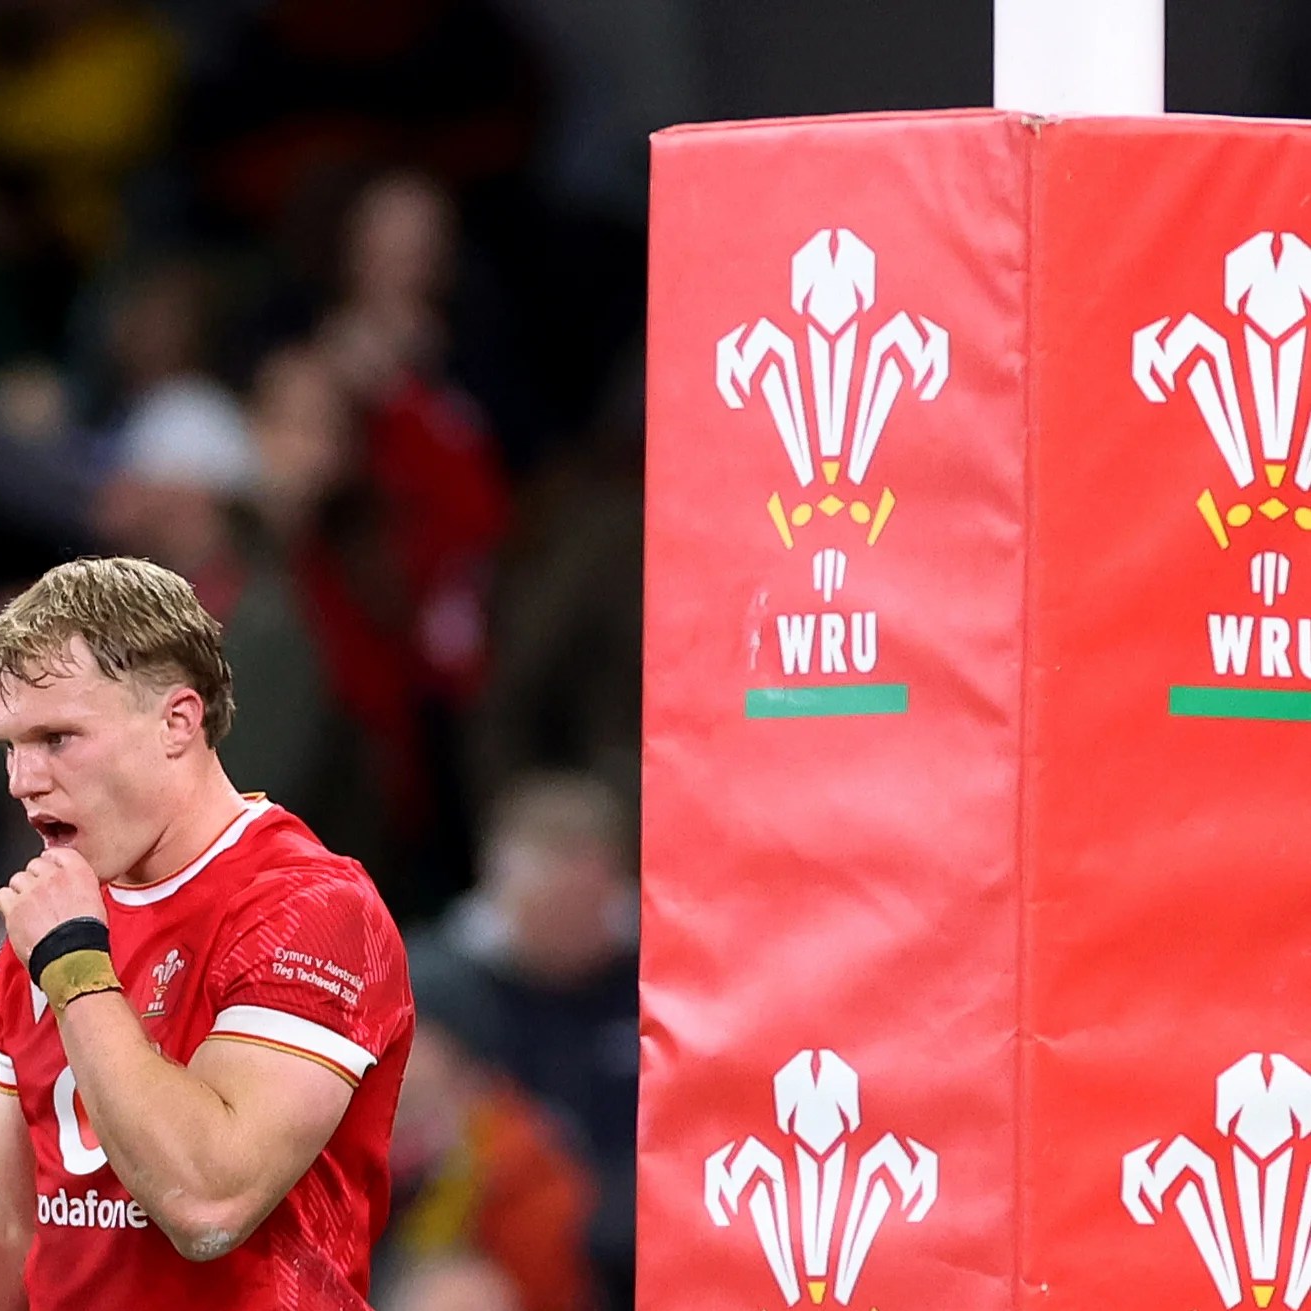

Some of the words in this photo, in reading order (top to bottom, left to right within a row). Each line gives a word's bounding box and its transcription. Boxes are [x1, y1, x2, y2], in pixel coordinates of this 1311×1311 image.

[777, 611, 877, 675] WRU
[274, 946, 312, 965] Cymru
[37, 1187, 149, 1229] odafone
